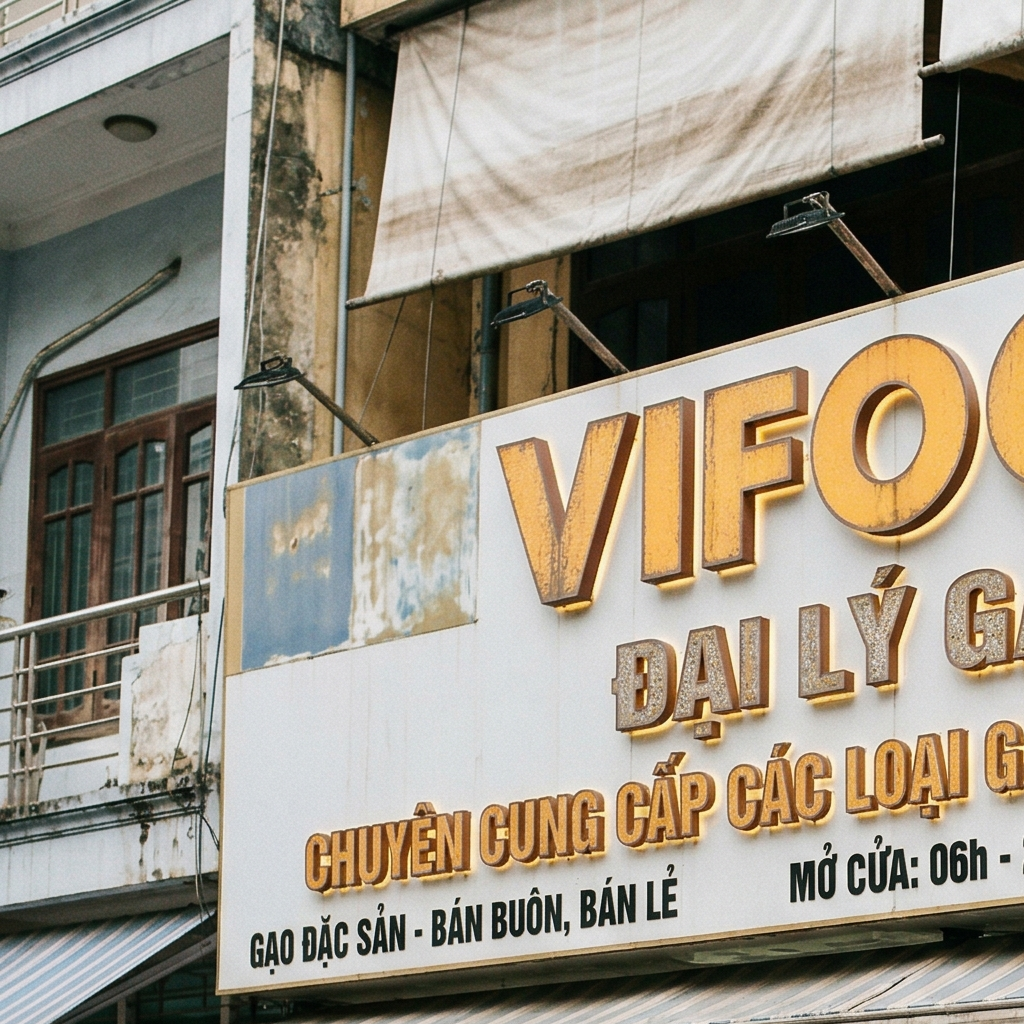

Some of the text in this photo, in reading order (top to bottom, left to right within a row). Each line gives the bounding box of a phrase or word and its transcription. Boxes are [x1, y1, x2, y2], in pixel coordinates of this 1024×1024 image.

[611, 616, 769, 740] ĐẠI
[799, 564, 917, 700] LÝ
[304, 802, 471, 893] CHUYÊN
[479, 789, 605, 867] CUNG
[616, 752, 715, 848] CẤP
[727, 742, 832, 831] CÁC
[845, 728, 969, 819] LOẠI
[790, 841, 838, 902] MỞ
[847, 834, 919, 895] CỬA:
[930, 838, 988, 885] 06h
[1000, 853, 1011, 863] -
[250, 930, 294, 974] GẠO
[301, 914, 348, 969] ĐẶC
[356, 903, 405, 954] SẢN
[431, 896, 483, 947] BÁN
[491, 887, 570, 939] BUÔN,
[580, 876, 636, 929] BÁN
[646, 863, 678, 920] LẺ
